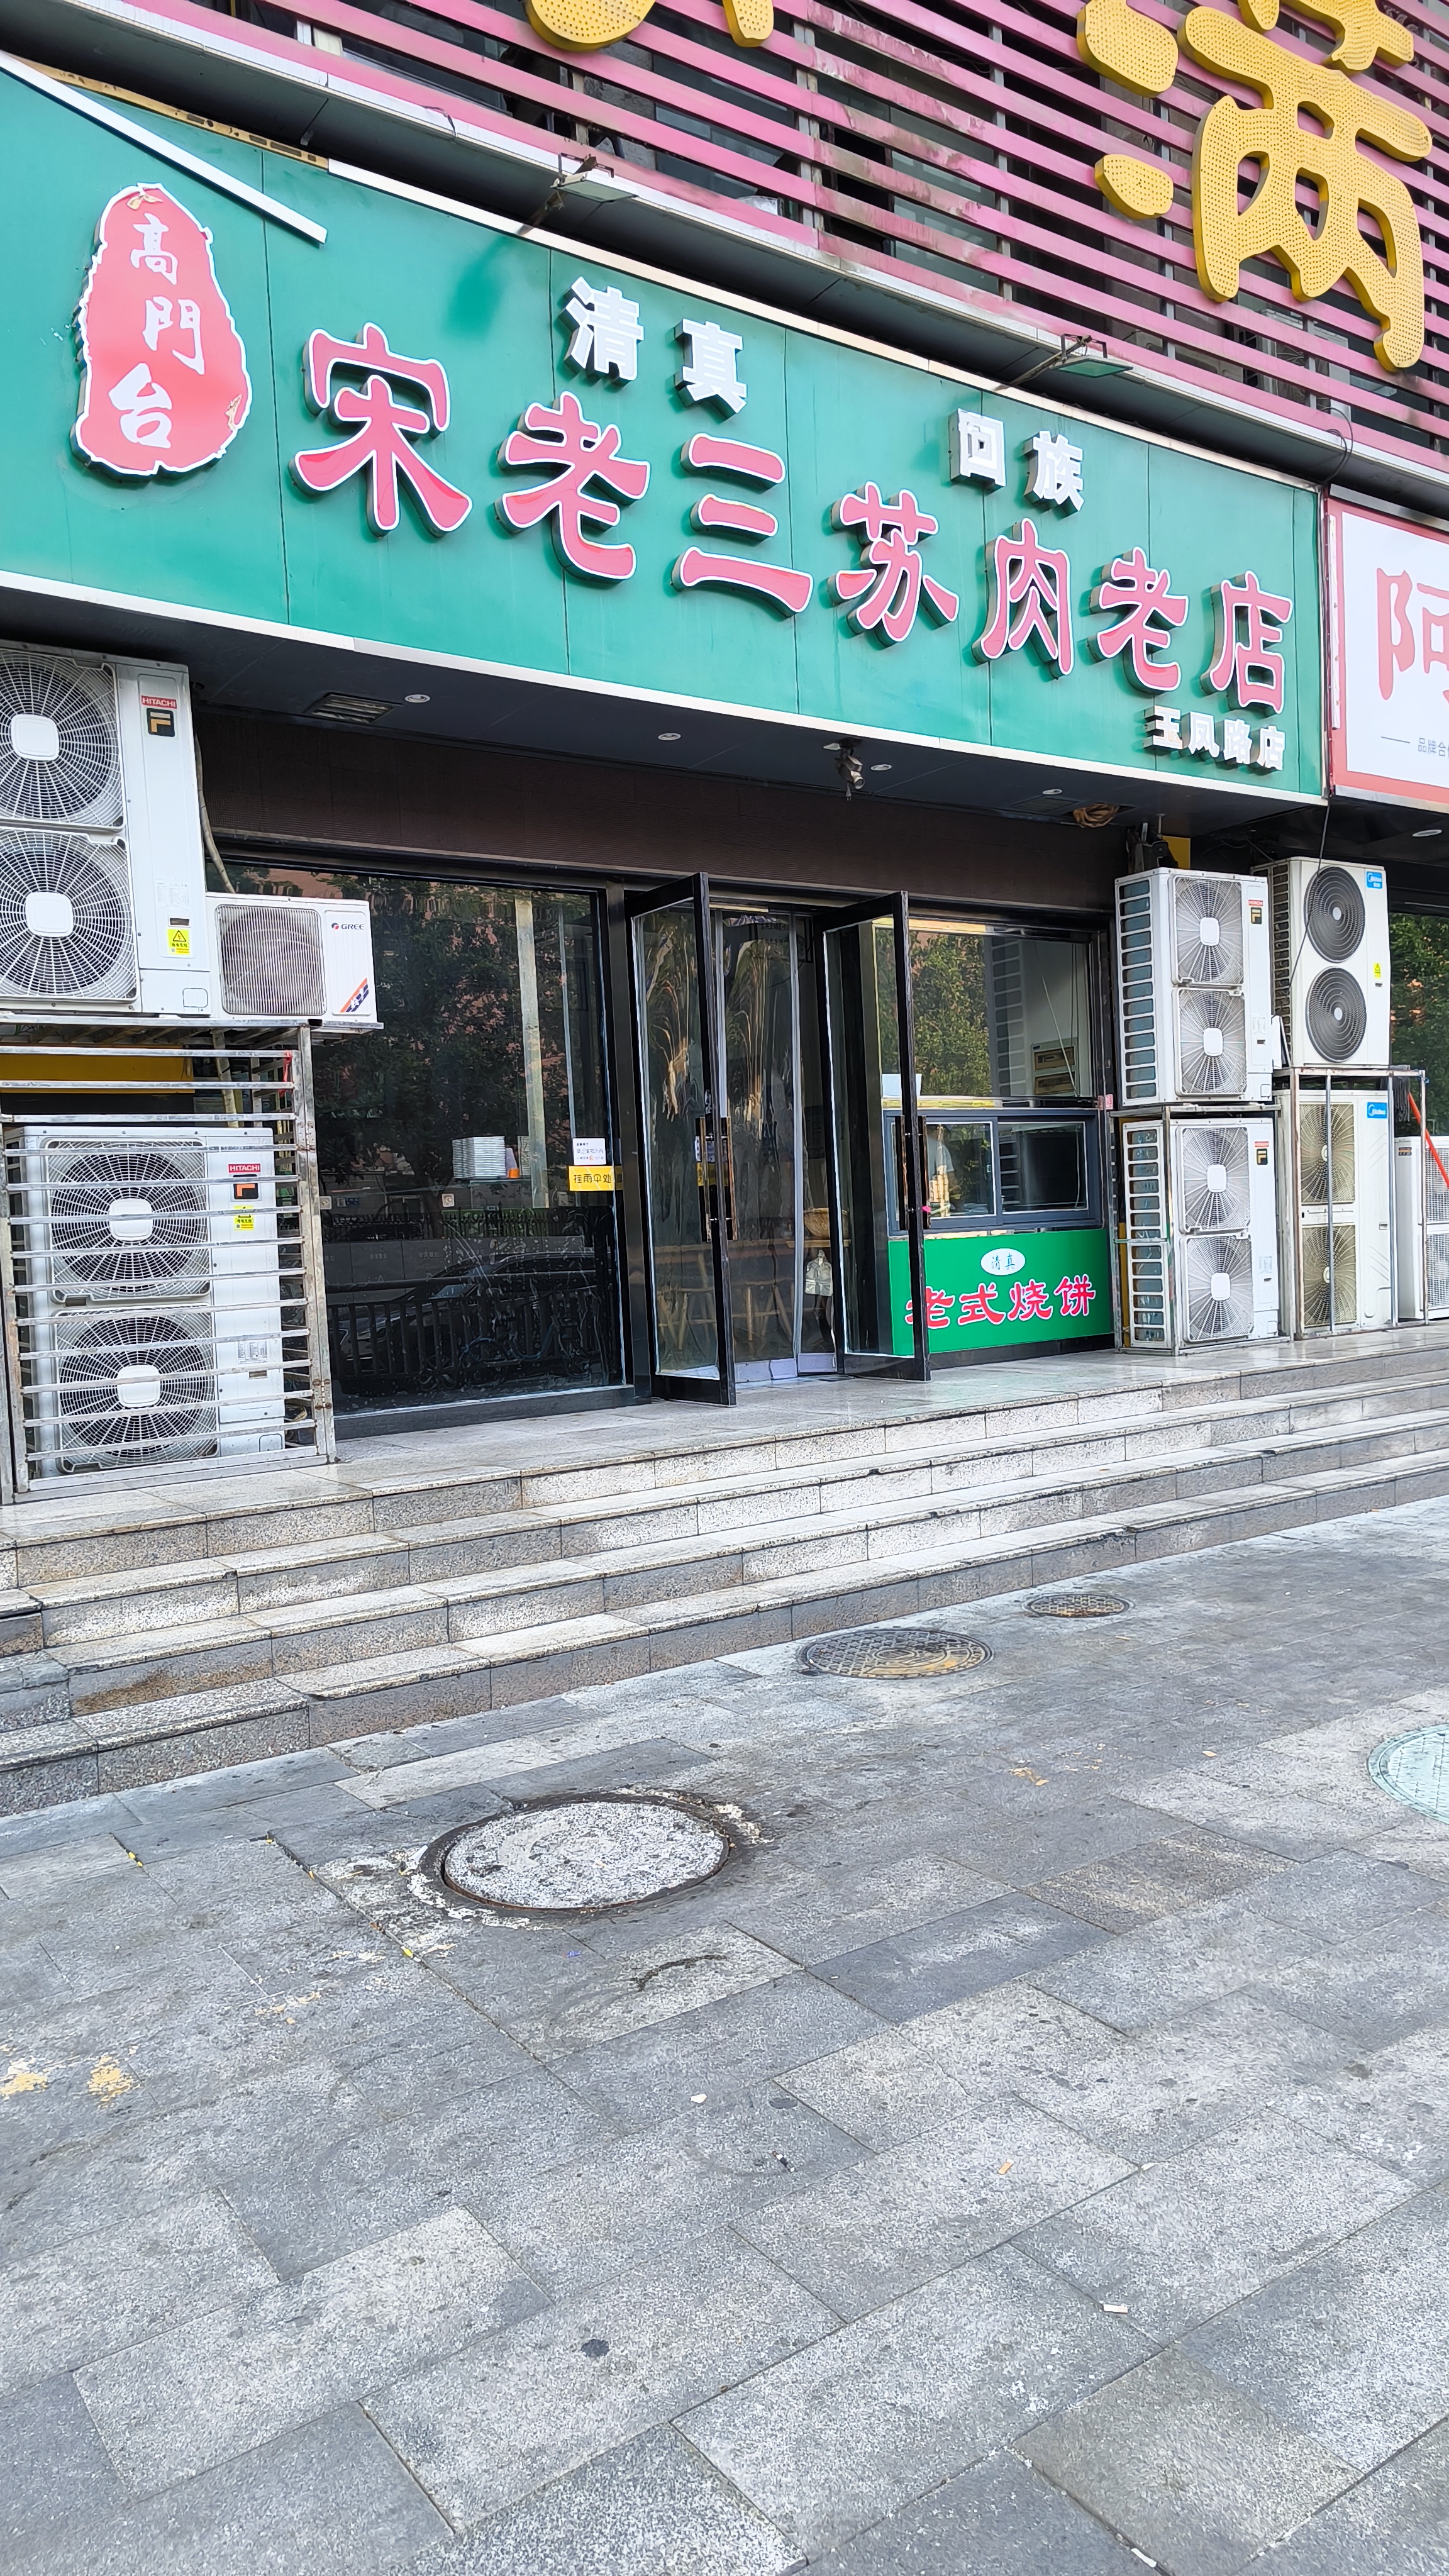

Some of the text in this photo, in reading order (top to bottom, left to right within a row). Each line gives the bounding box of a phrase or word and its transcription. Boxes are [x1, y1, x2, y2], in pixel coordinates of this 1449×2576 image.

[565, 275, 747, 413] 清真
[956, 408, 1085, 512] 回族
[292, 322, 1293, 716] 宋老三苏肉老店
[142, 697, 175, 707] HITACHI
[1152, 705, 1285, 770] 玉凤路店
[1418, 737, 1449, 758] 品牌合
[574, 1174, 612, 1184] 挂雨伞处
[991, 1253, 1015, 1270] 清真
[905, 1274, 1096, 1330] 老式烧饼
